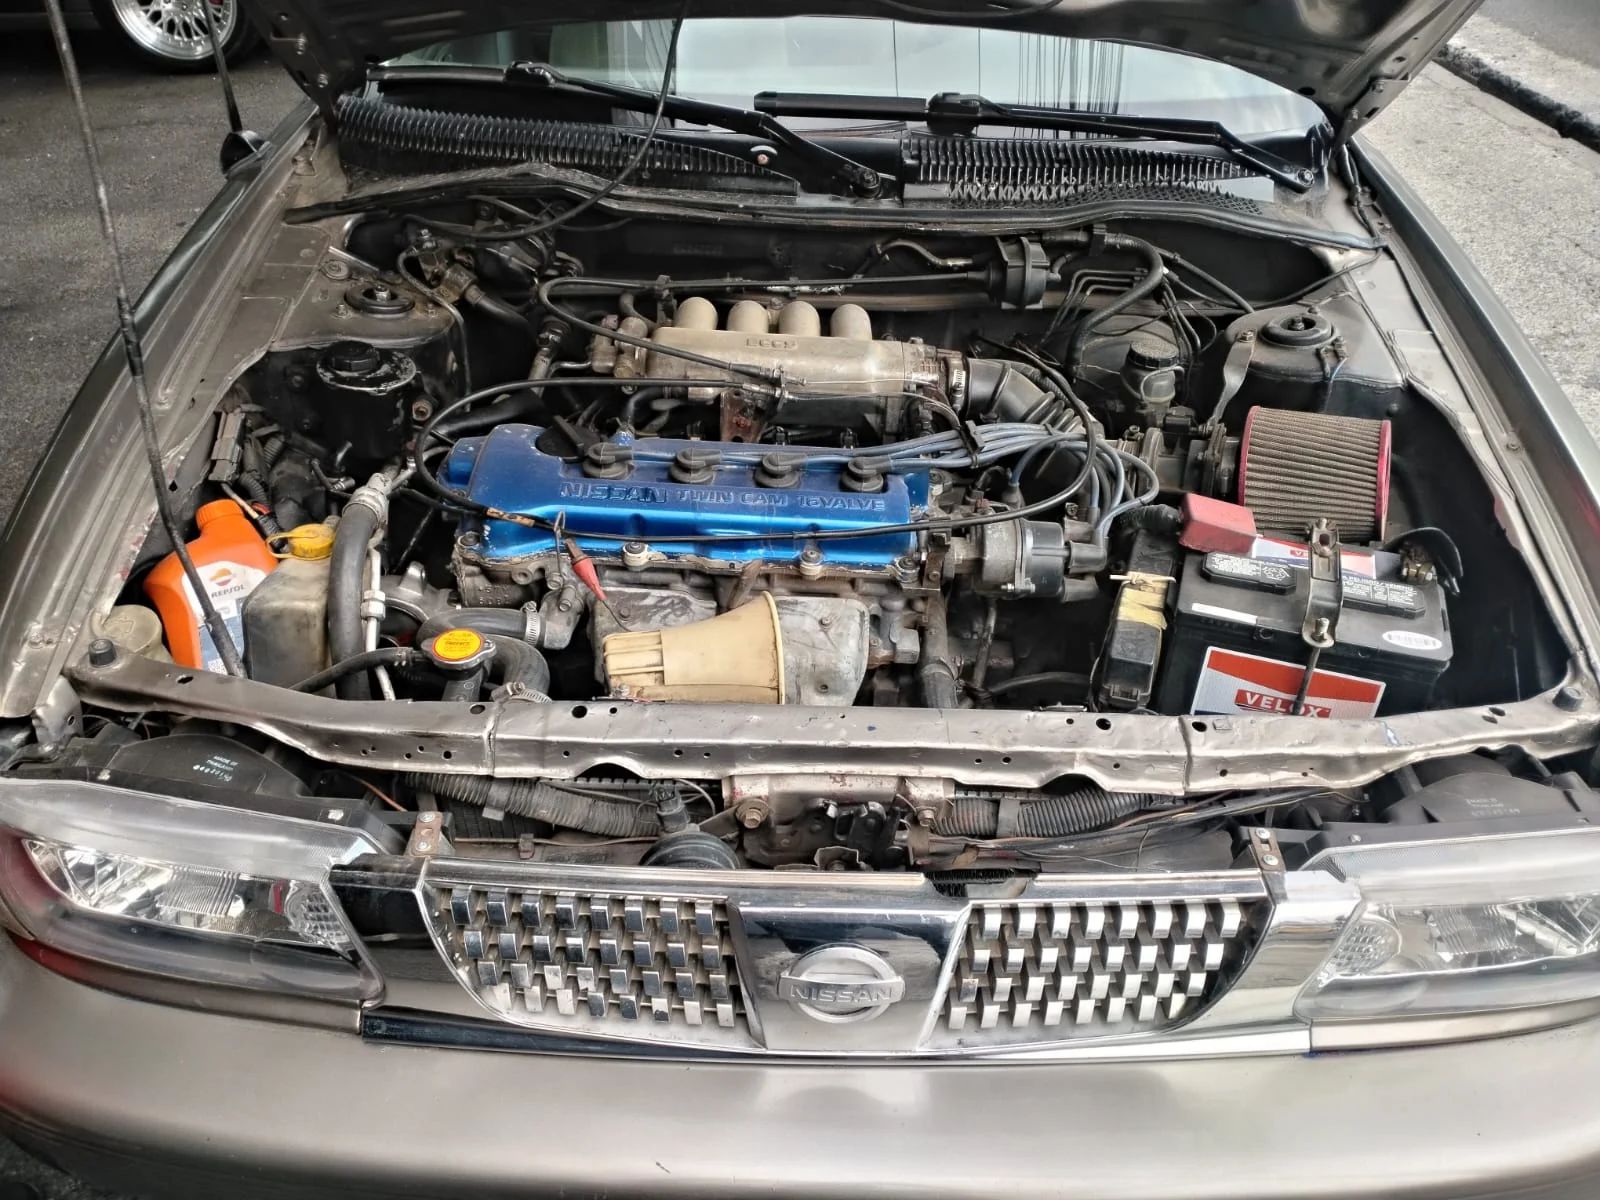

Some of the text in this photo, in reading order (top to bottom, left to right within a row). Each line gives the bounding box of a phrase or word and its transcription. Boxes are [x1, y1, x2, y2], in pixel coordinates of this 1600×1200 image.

[560, 482, 668, 503] NISSAN
[678, 488, 735, 504] TWIN
[741, 491, 789, 507] CAM
[211, 584, 245, 598] REPSOL
[790, 985, 892, 1003] NISSAN
